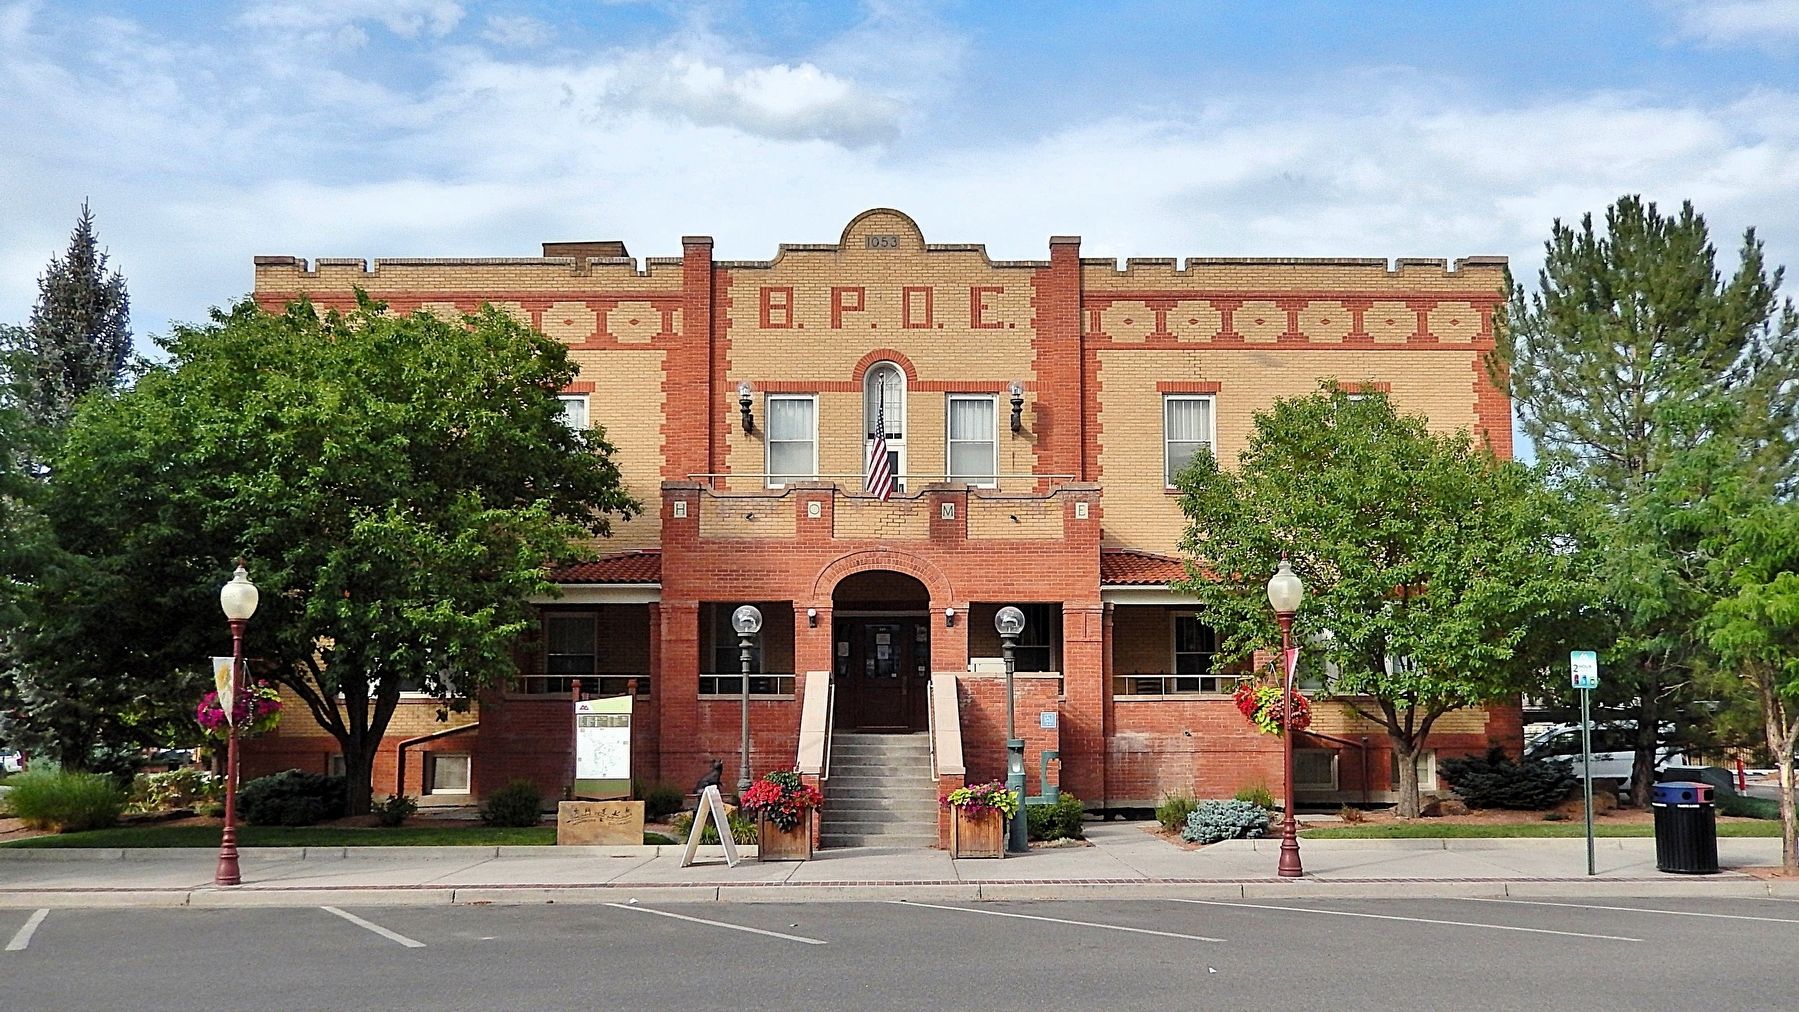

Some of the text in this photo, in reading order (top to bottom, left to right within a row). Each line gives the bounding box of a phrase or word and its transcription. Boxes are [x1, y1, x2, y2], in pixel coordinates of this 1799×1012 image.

[867, 236, 897, 248] 1053
[676, 503, 1086, 517] H O M E
[1573, 664, 1578, 672] 2
